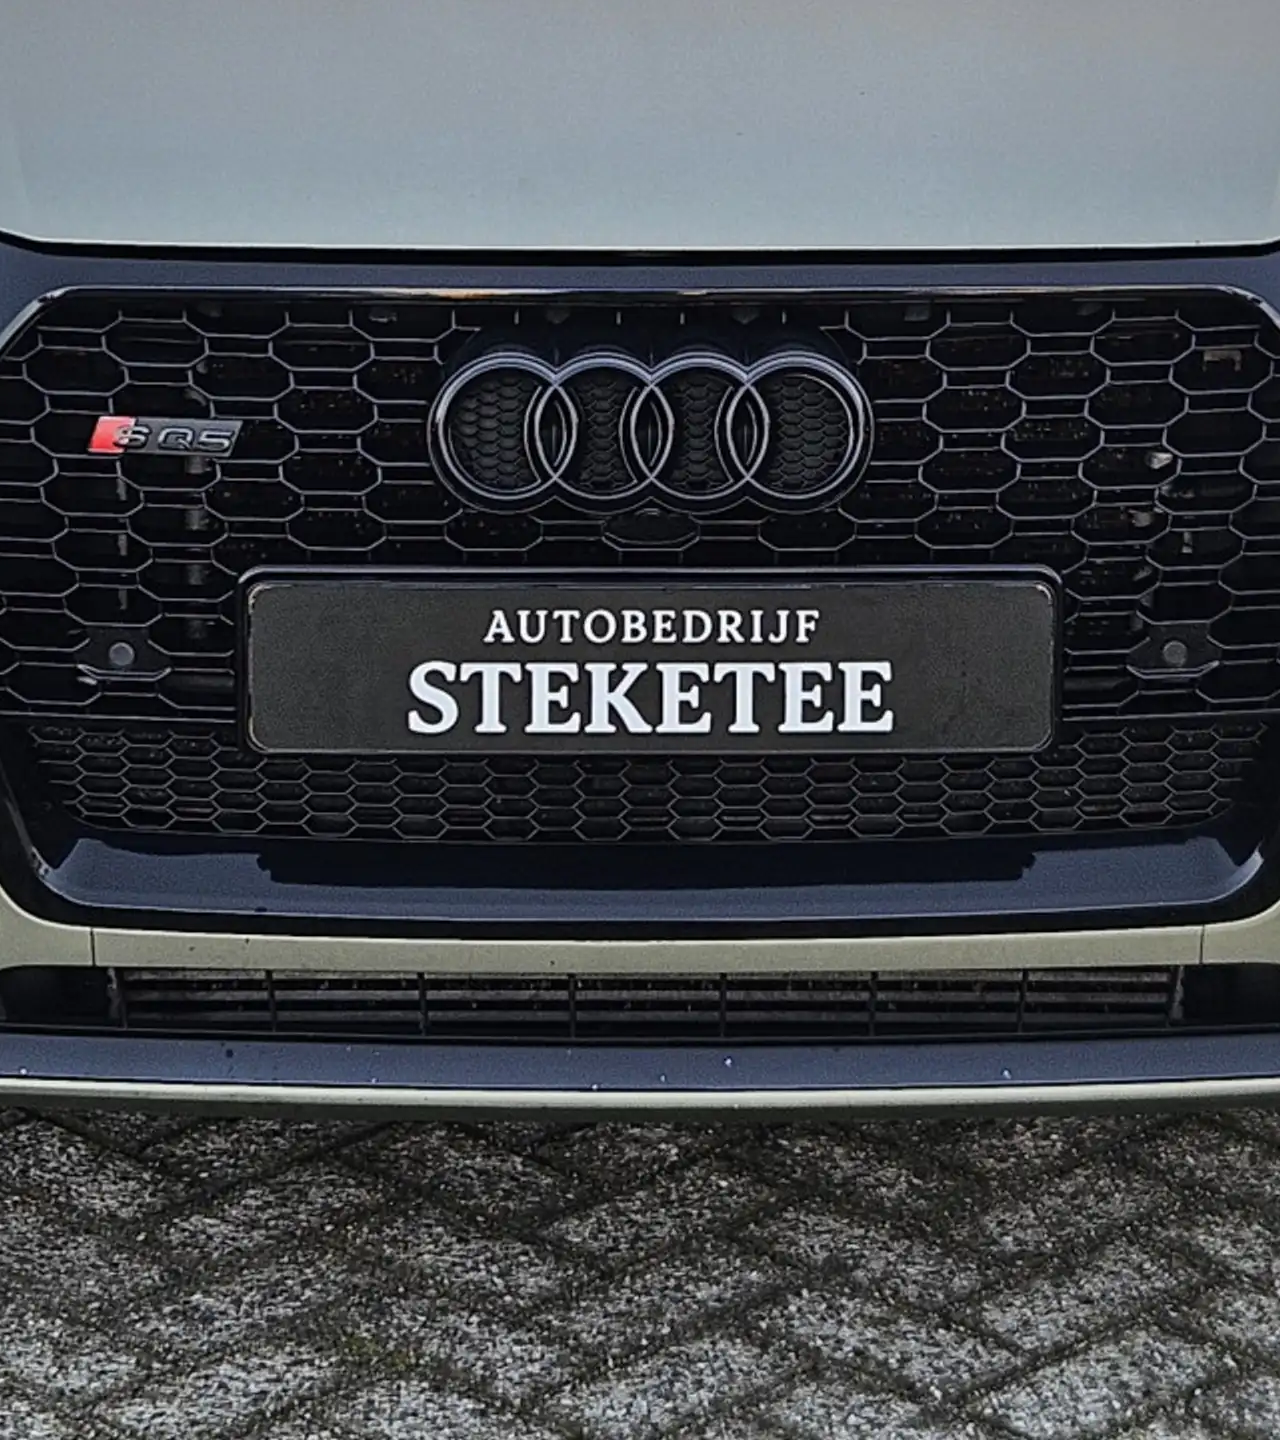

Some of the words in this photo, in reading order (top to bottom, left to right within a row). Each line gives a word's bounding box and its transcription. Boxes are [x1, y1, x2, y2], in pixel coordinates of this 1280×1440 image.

[113, 424, 232, 452] SQ5
[483, 609, 820, 644] AUTOBEDRIJF
[408, 660, 894, 734] STEKETEE
